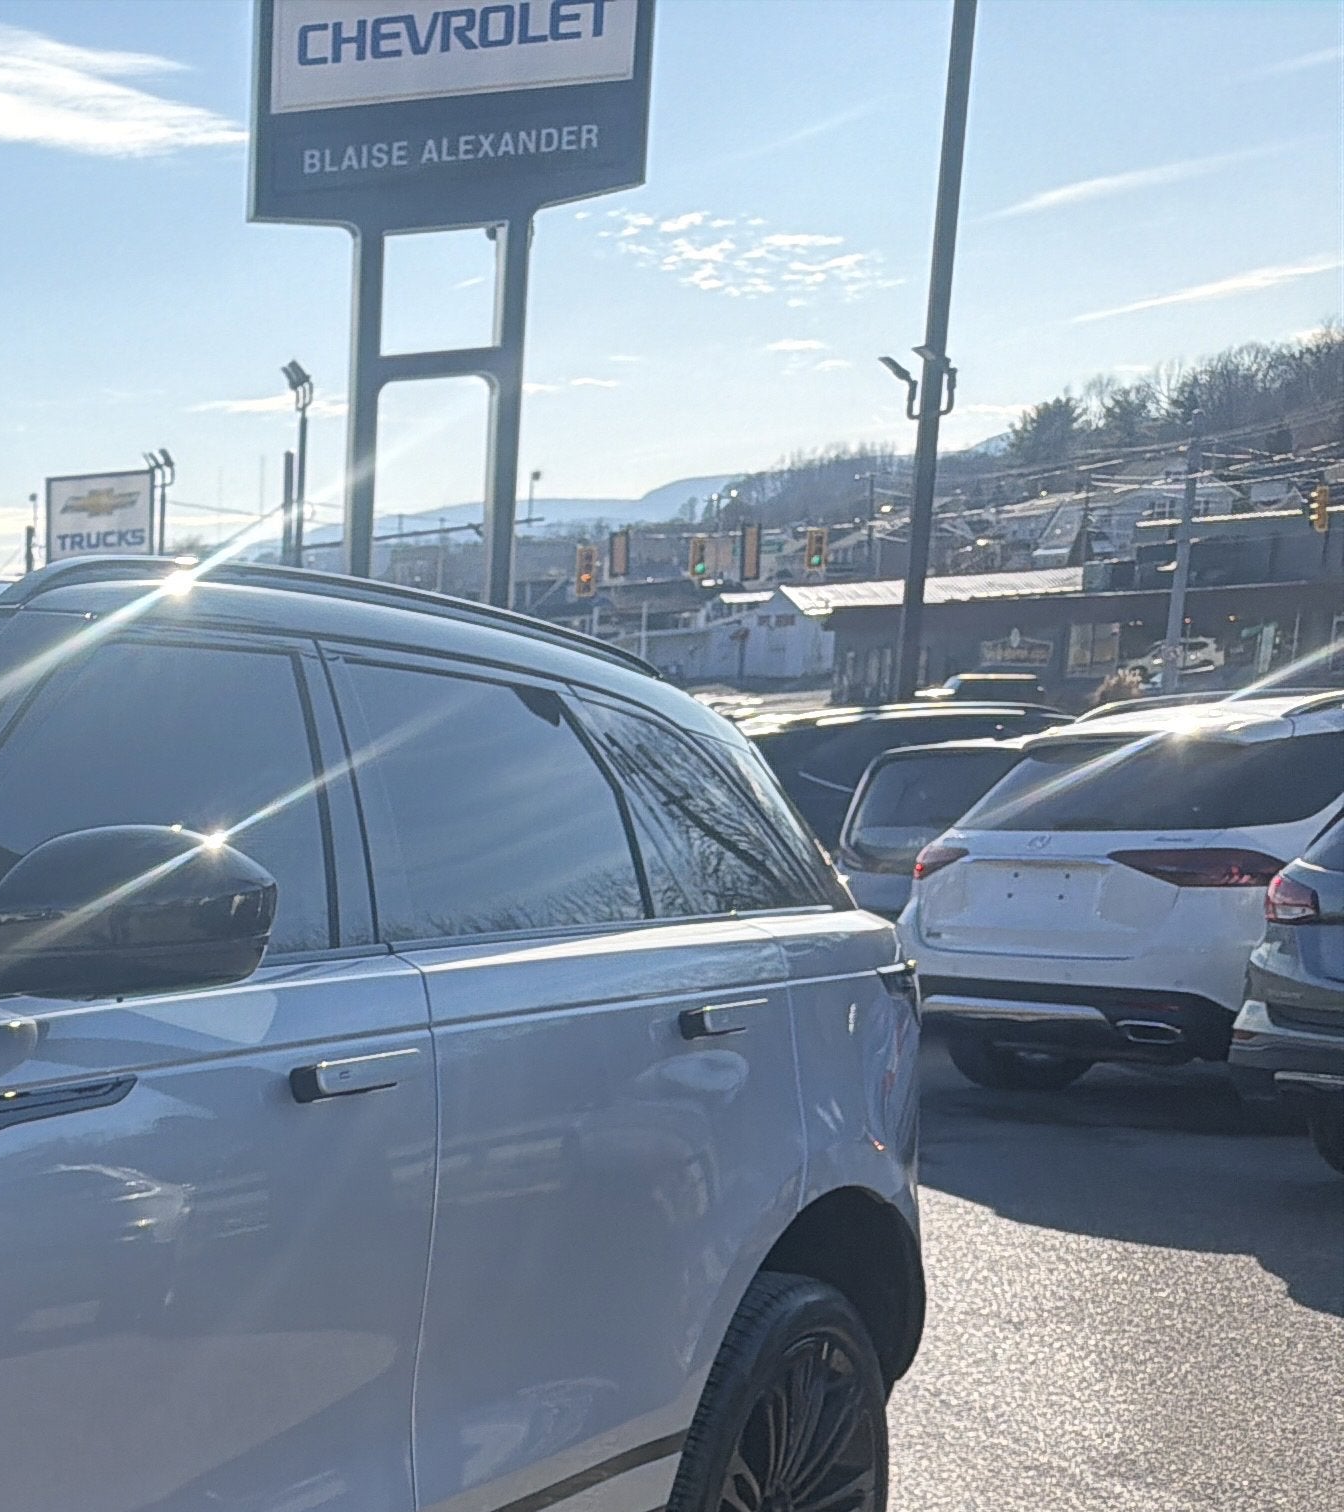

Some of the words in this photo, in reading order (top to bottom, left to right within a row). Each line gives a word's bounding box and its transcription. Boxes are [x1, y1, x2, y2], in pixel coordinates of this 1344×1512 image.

[298, 0, 612, 66] CHEVROLET
[303, 141, 408, 174] BLAISE
[421, 124, 599, 164] ALEXANDER
[56, 528, 145, 550] TRUCKS
